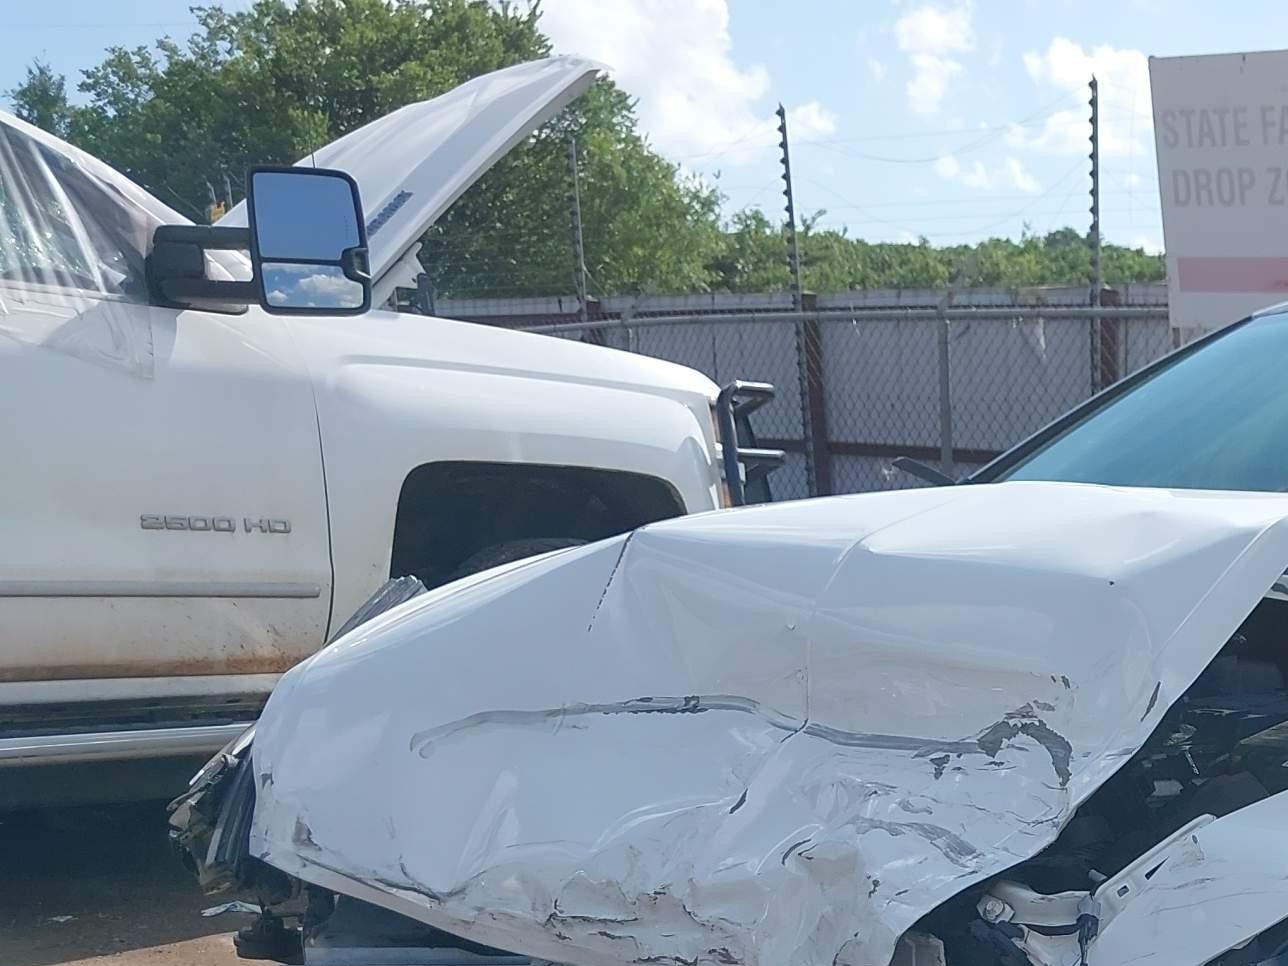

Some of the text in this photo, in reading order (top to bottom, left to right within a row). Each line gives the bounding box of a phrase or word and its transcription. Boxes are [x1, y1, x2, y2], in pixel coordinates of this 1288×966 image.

[1161, 107, 1249, 148] STATE
[1173, 168, 1255, 206] DROP
[139, 514, 292, 533] 2500 HD
